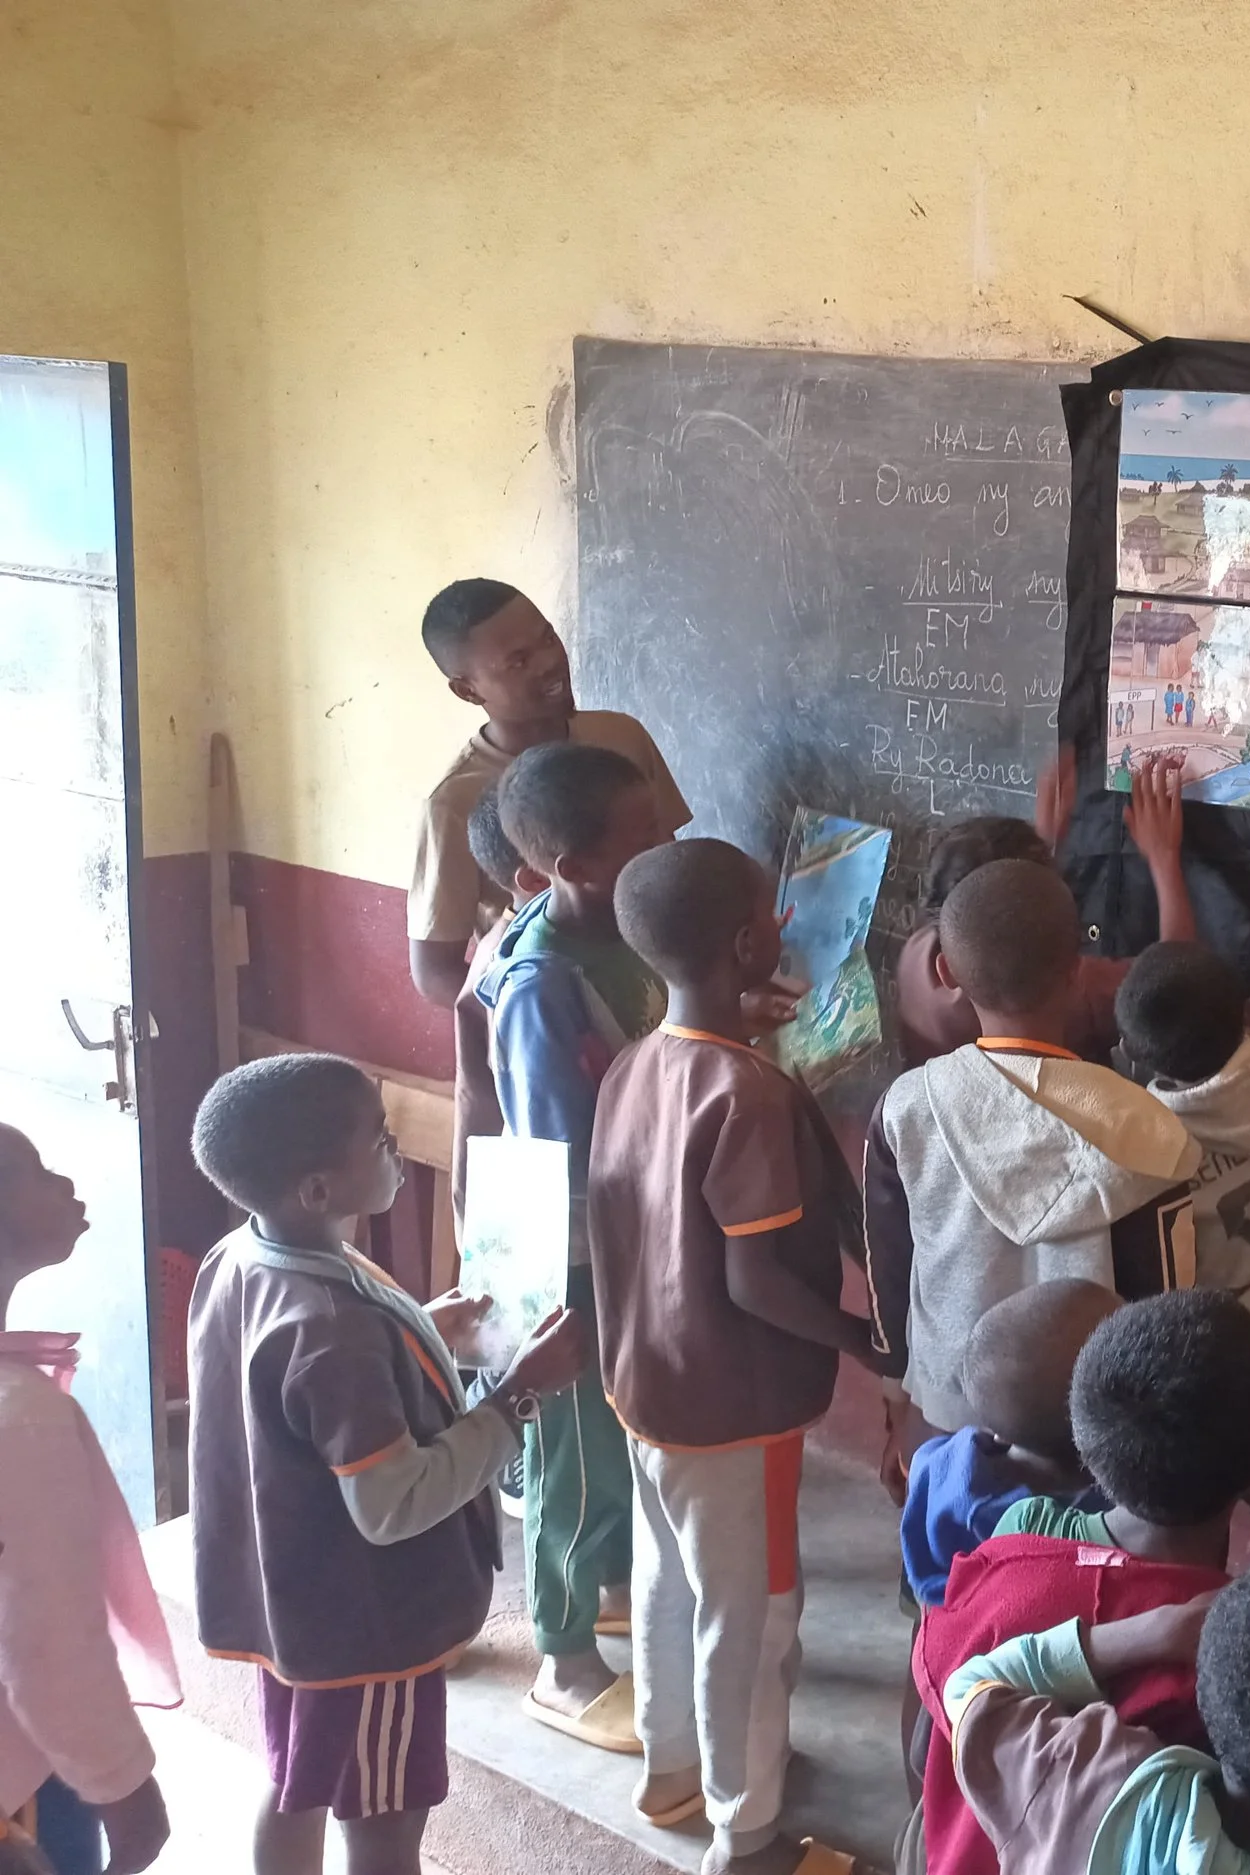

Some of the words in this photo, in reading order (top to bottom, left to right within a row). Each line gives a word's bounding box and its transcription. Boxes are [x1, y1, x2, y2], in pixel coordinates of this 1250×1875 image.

[977, 483, 1009, 537] ny
[1026, 570, 1063, 631] ny
[926, 608, 969, 650] EM
[1127, 691, 1142, 701] EPP
